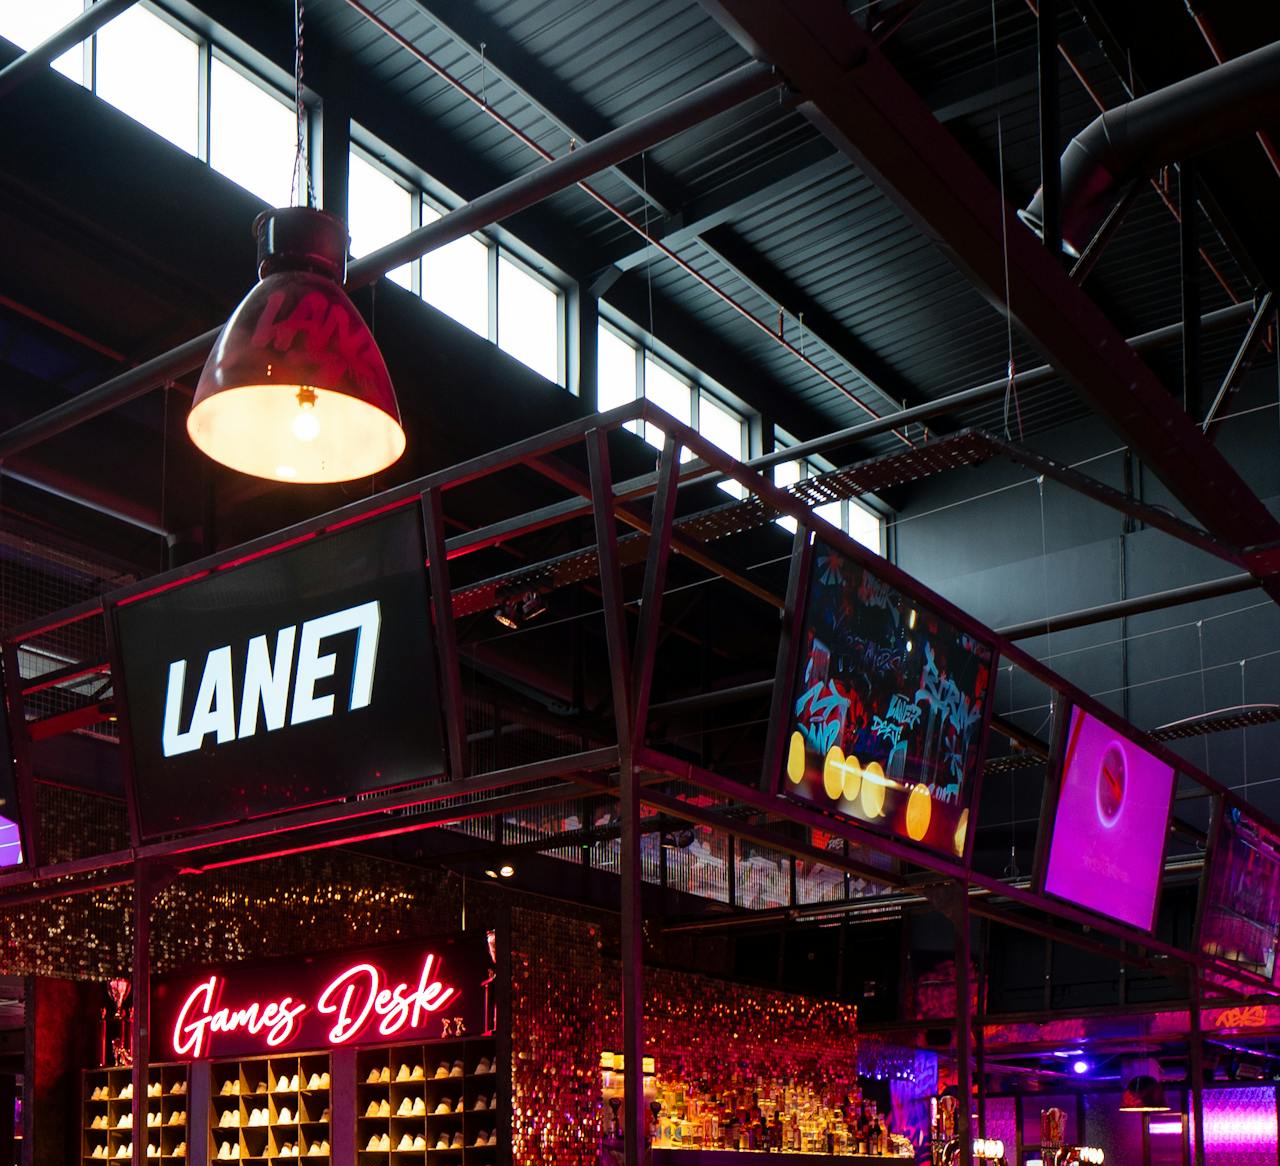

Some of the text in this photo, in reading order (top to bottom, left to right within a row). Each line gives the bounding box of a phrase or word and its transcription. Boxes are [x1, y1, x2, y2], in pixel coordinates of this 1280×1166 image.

[162, 600, 381, 758] LANE7
[173, 953, 454, 1058] Games Desk
